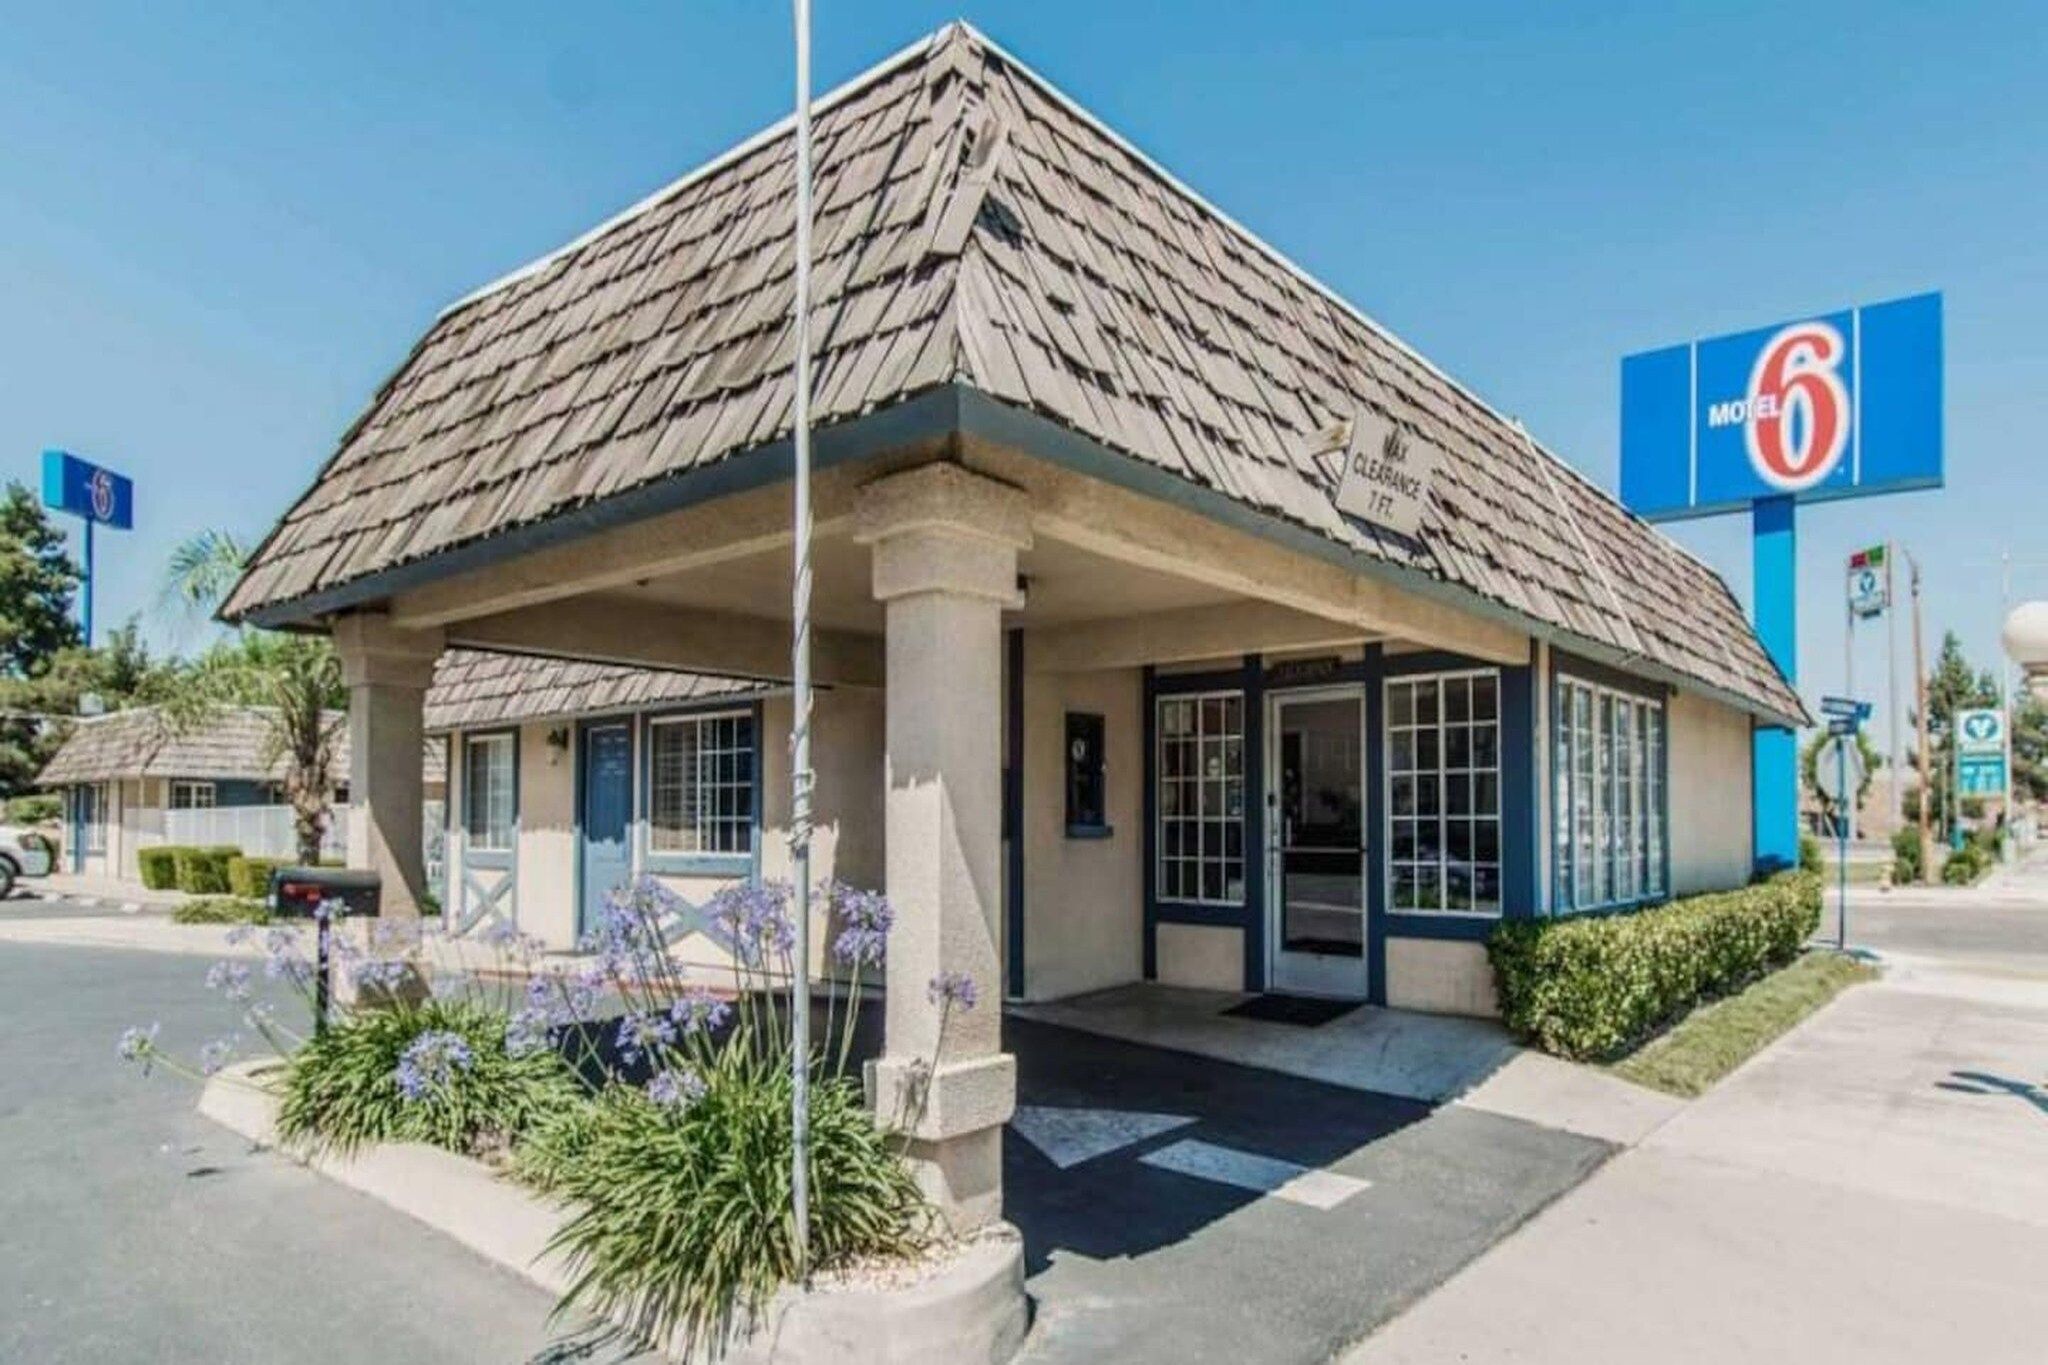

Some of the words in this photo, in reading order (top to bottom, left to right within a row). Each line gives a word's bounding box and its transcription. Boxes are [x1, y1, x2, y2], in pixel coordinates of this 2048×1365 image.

[1708, 394, 1780, 428] MOTEL
[1745, 321, 1850, 490] 6
[91, 467, 115, 521] 6
[1353, 452, 1421, 501] CLEARANCE
